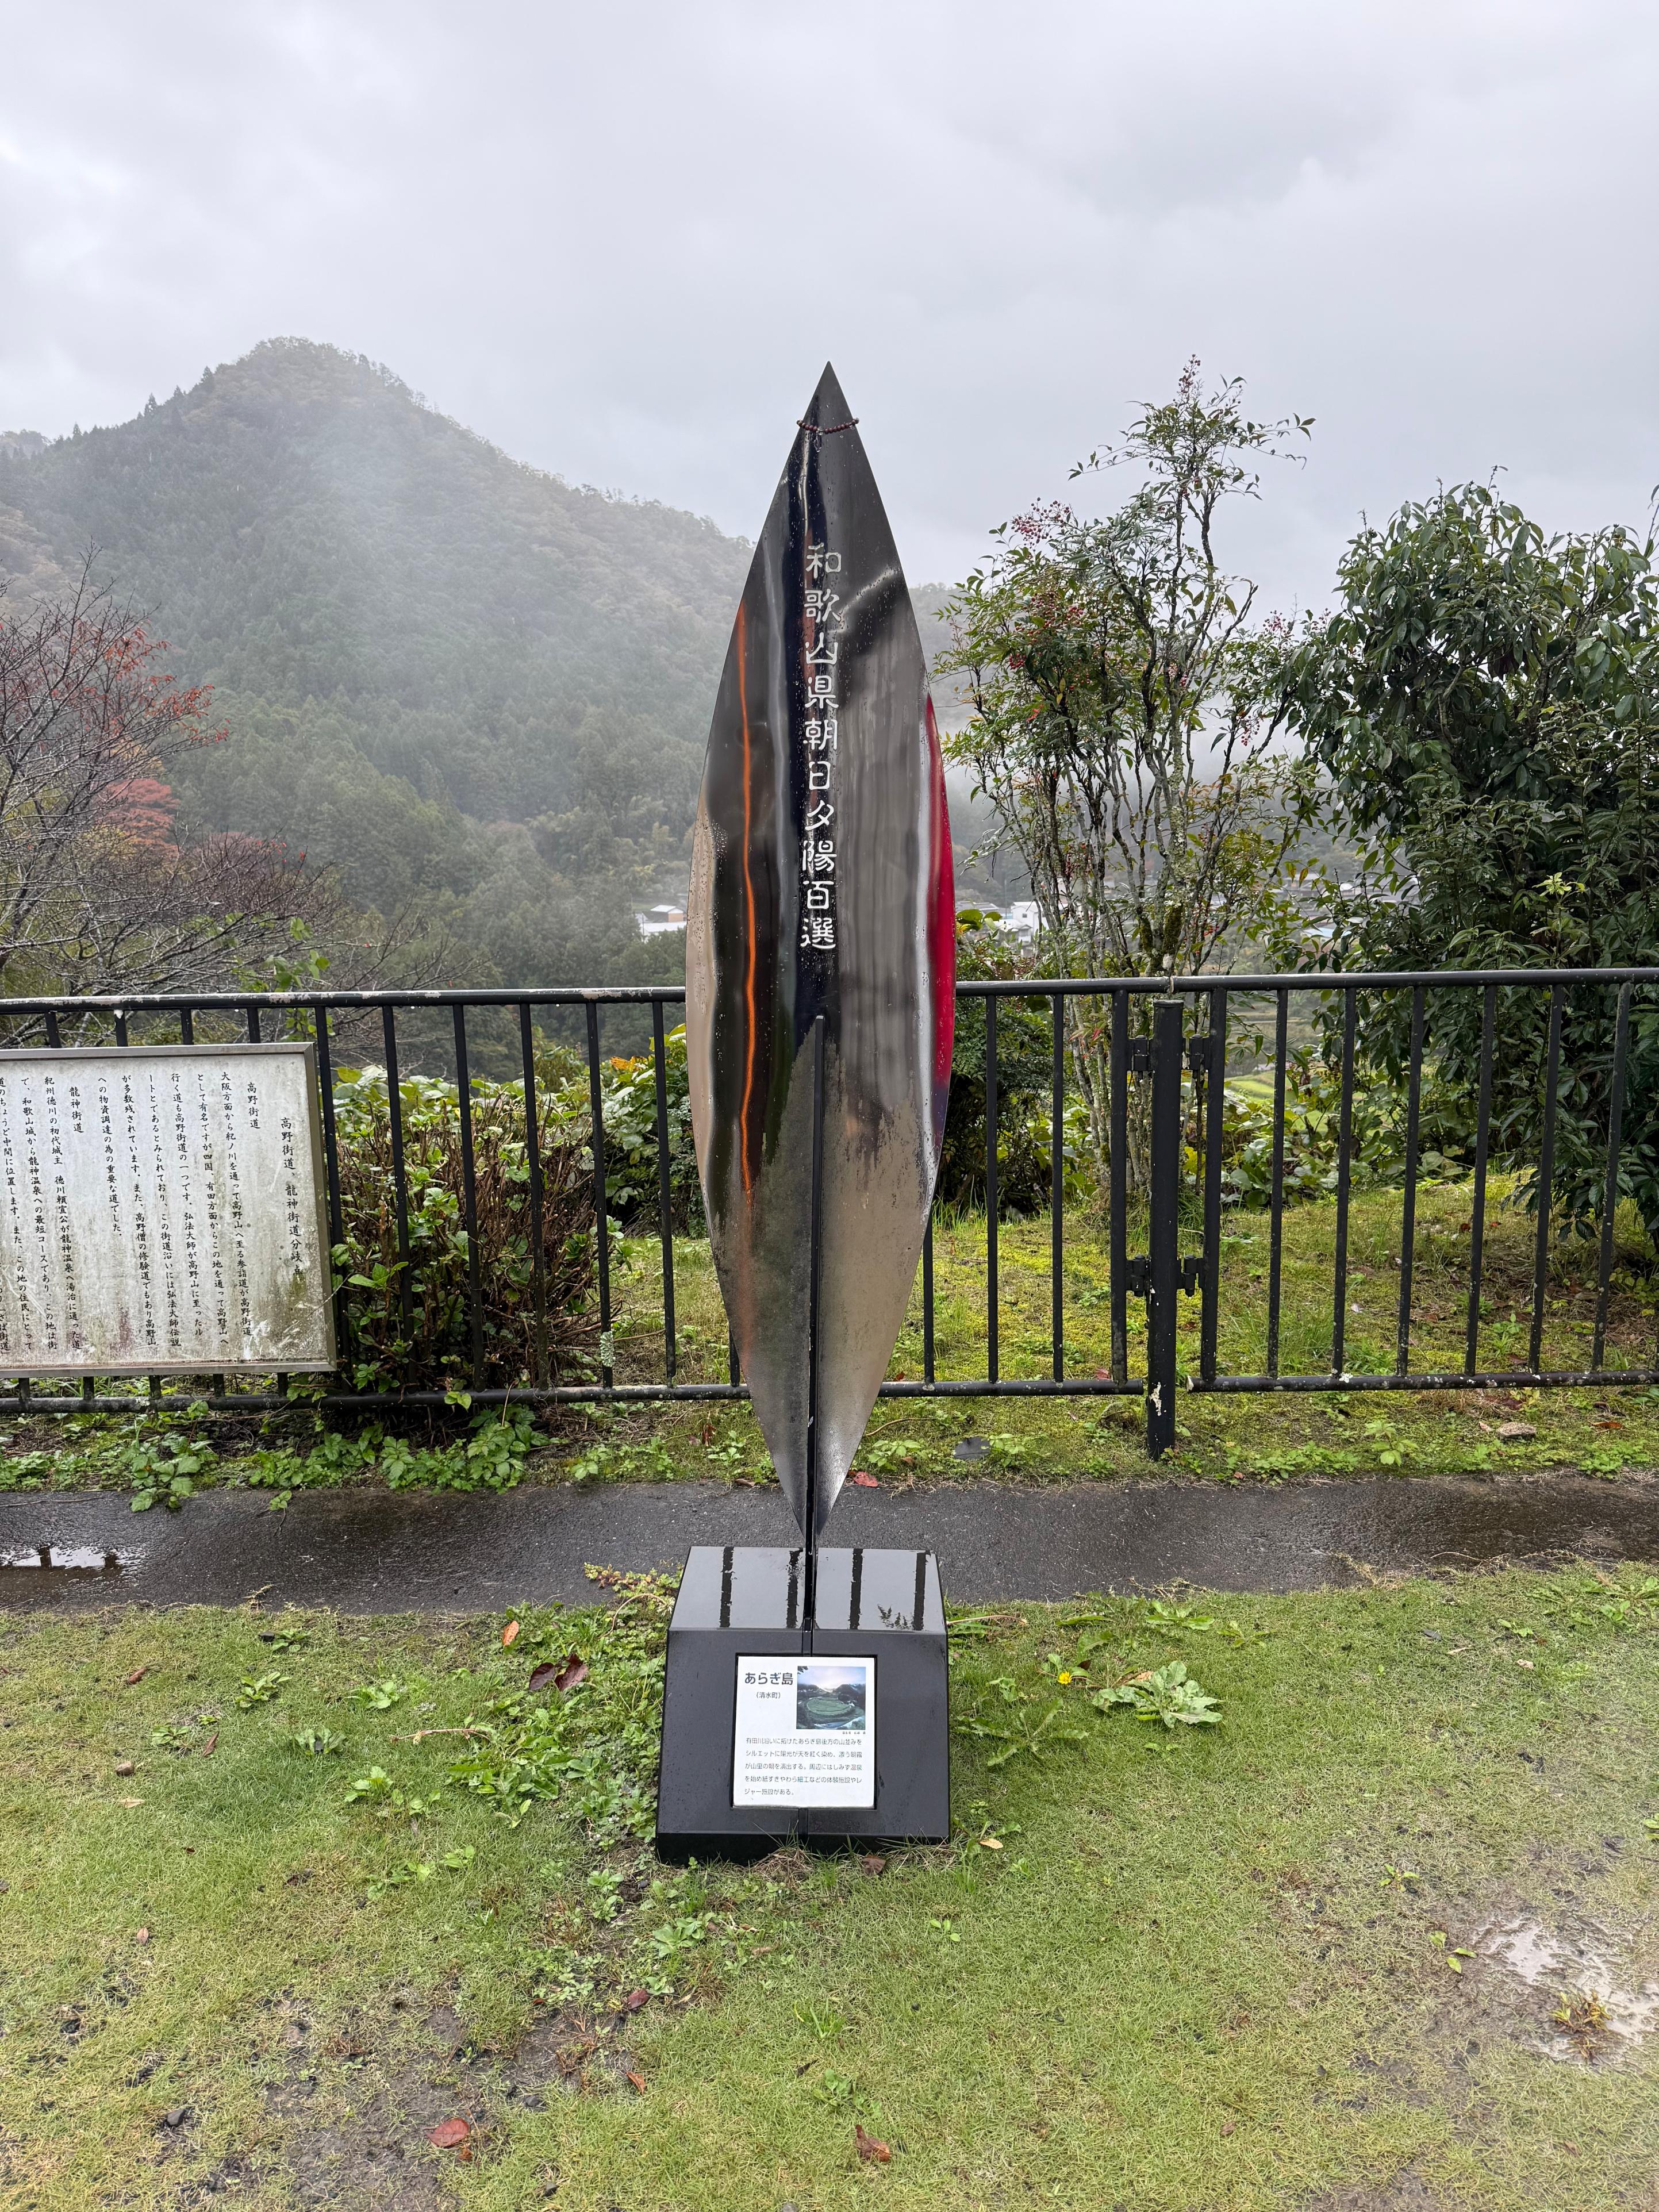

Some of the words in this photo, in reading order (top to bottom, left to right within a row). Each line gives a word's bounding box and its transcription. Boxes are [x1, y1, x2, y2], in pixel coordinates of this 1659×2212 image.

[801, 542, 842, 950] 和歌山県朝日夕陽百選
[69, 1086, 84, 1133] 龍神街道
[247, 1082, 260, 1129] 高野街道
[281, 1117, 303, 1276] 高野街道、龍神街道分岐点
[744, 1672, 793, 1685] あらぎ島
